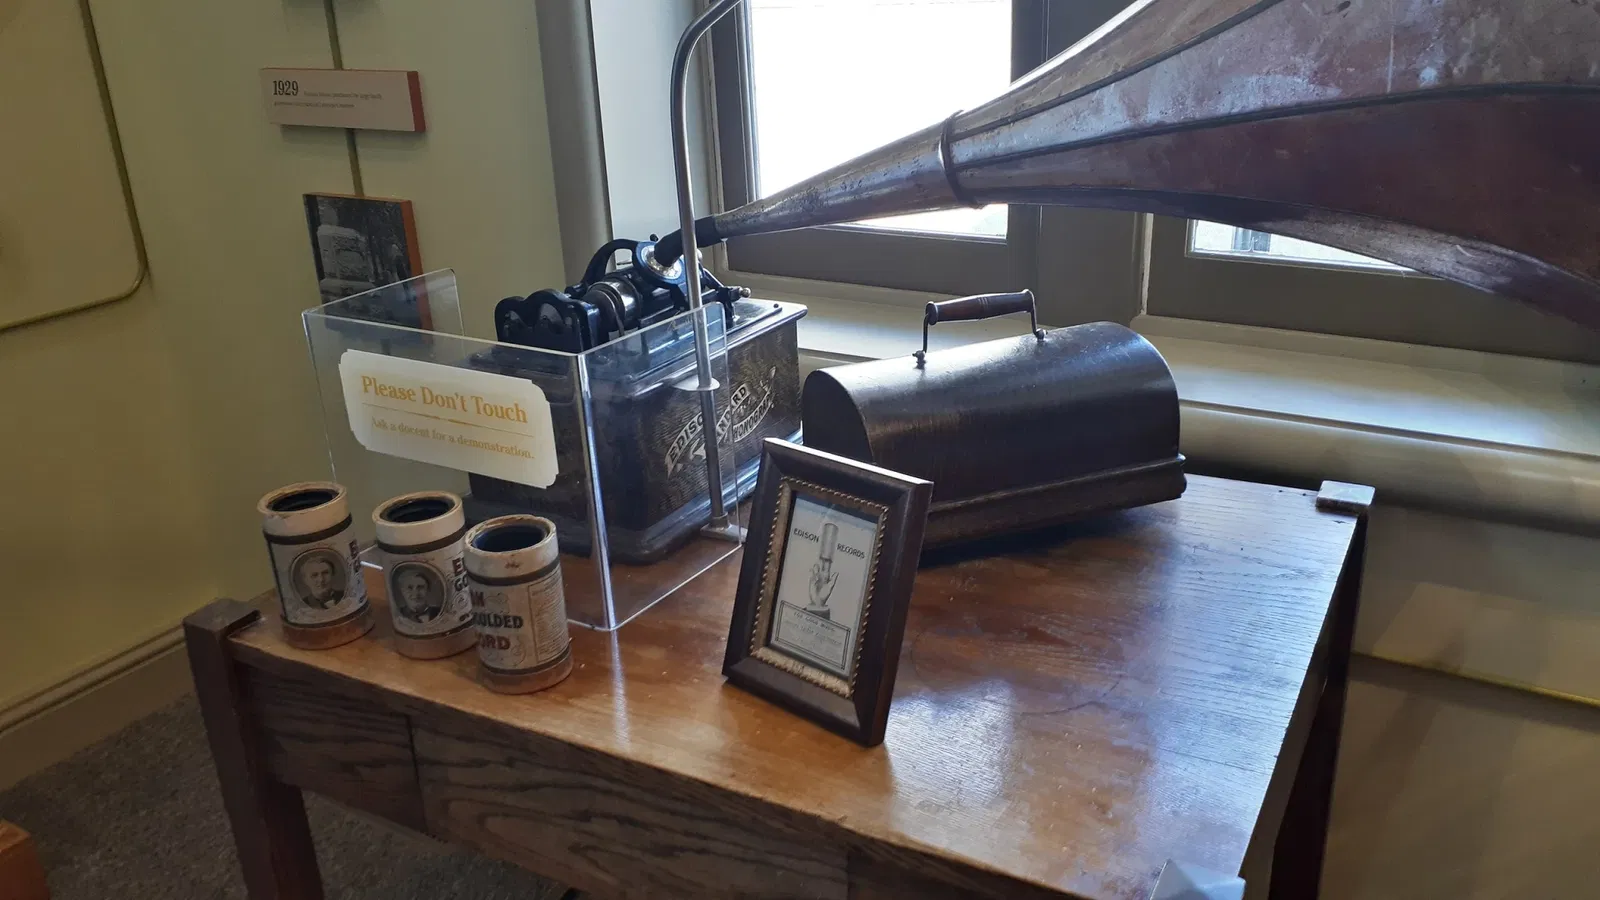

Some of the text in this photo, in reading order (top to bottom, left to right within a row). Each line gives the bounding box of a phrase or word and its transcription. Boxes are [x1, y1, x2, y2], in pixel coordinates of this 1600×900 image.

[272, 79, 299, 96] 1929
[361, 375, 528, 424] Please Don't Touch
[371, 416, 535, 459] Ask a docent for a demonstration.
[668, 414, 704, 463] EDISO
[793, 528, 865, 559] EDISON RECORDS
